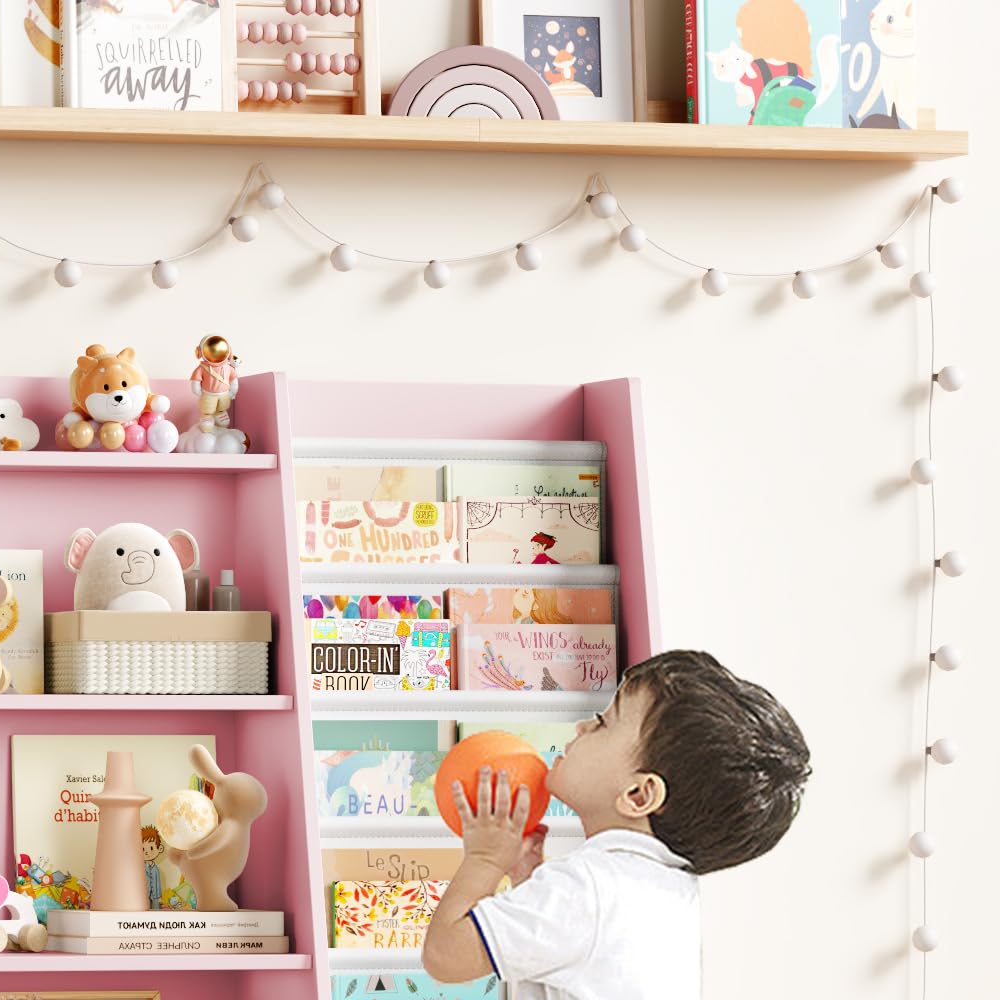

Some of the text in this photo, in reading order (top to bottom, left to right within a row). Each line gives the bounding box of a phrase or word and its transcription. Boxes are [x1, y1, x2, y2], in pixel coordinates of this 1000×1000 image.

[95, 36, 203, 71] SQUIRRELLED
[100, 63, 201, 111] away
[359, 523, 439, 552] HUNDRED
[517, 631, 568, 650] WINGS
[572, 635, 612, 655] already
[66, 774, 90, 783] Xavier
[366, 850, 386, 871] Le
